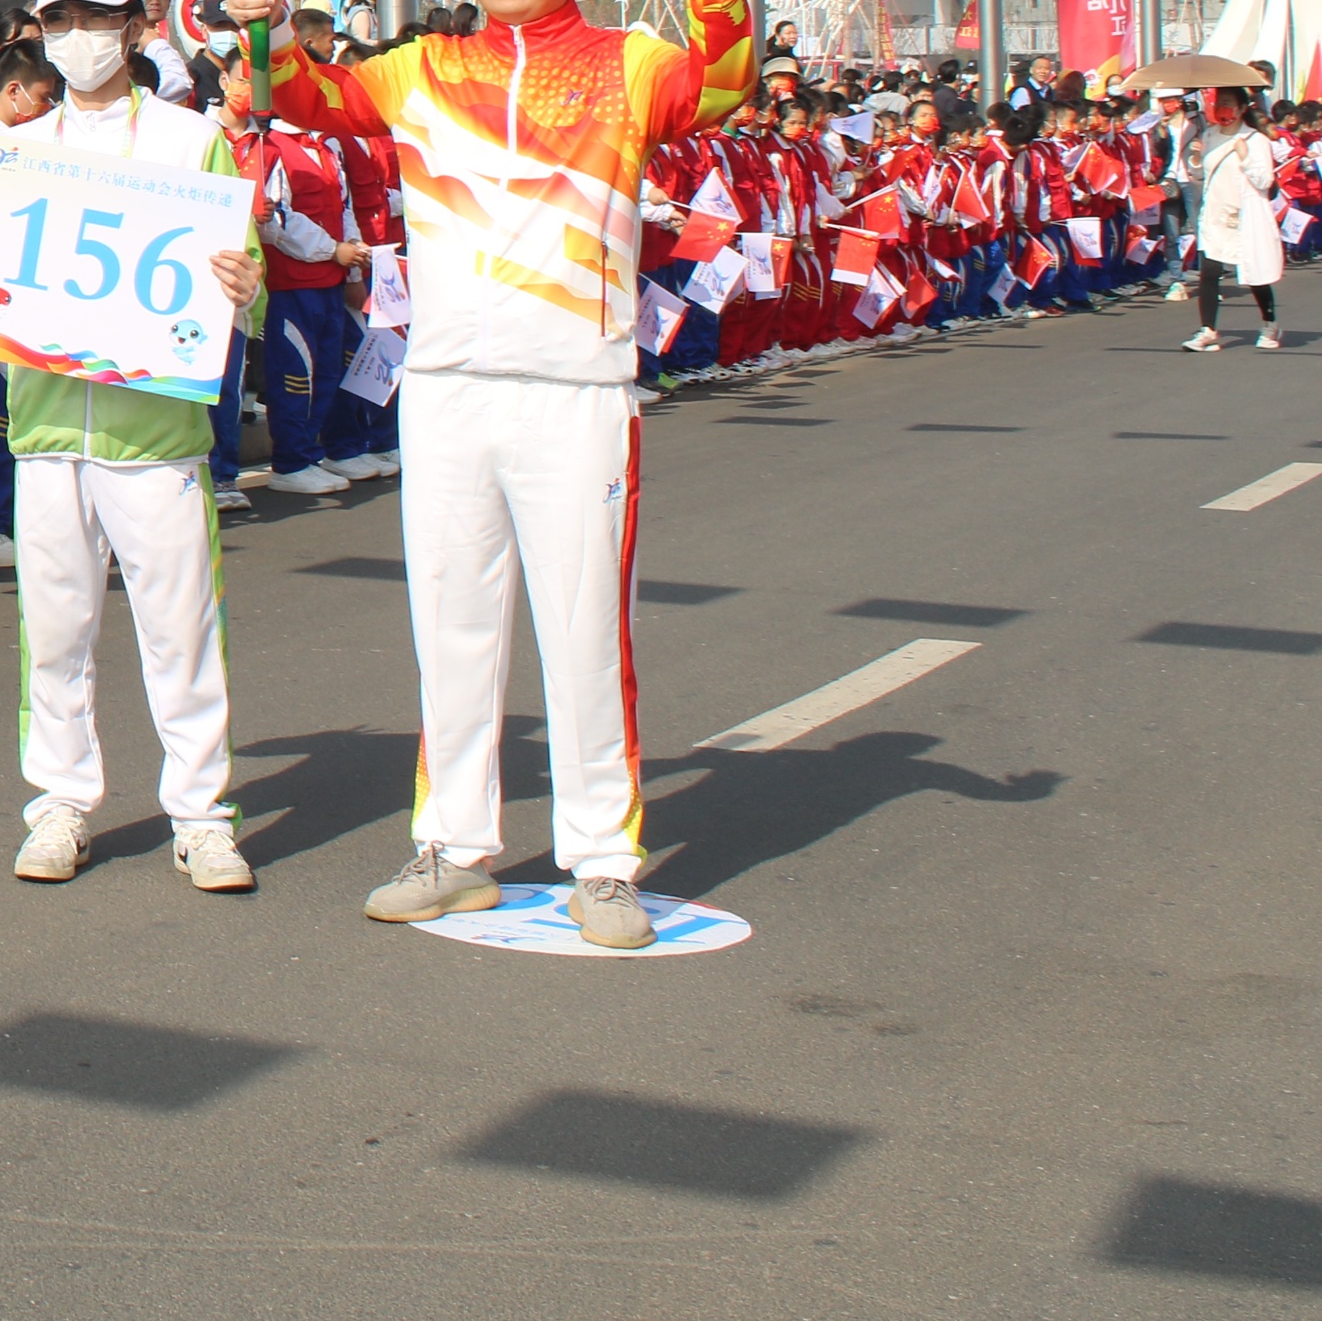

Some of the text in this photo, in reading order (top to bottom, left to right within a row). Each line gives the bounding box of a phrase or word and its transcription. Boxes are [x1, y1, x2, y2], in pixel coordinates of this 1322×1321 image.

[21, 154, 235, 209] 江西省第十六届运动会火炬传递
[3, 197, 195, 316] 156
